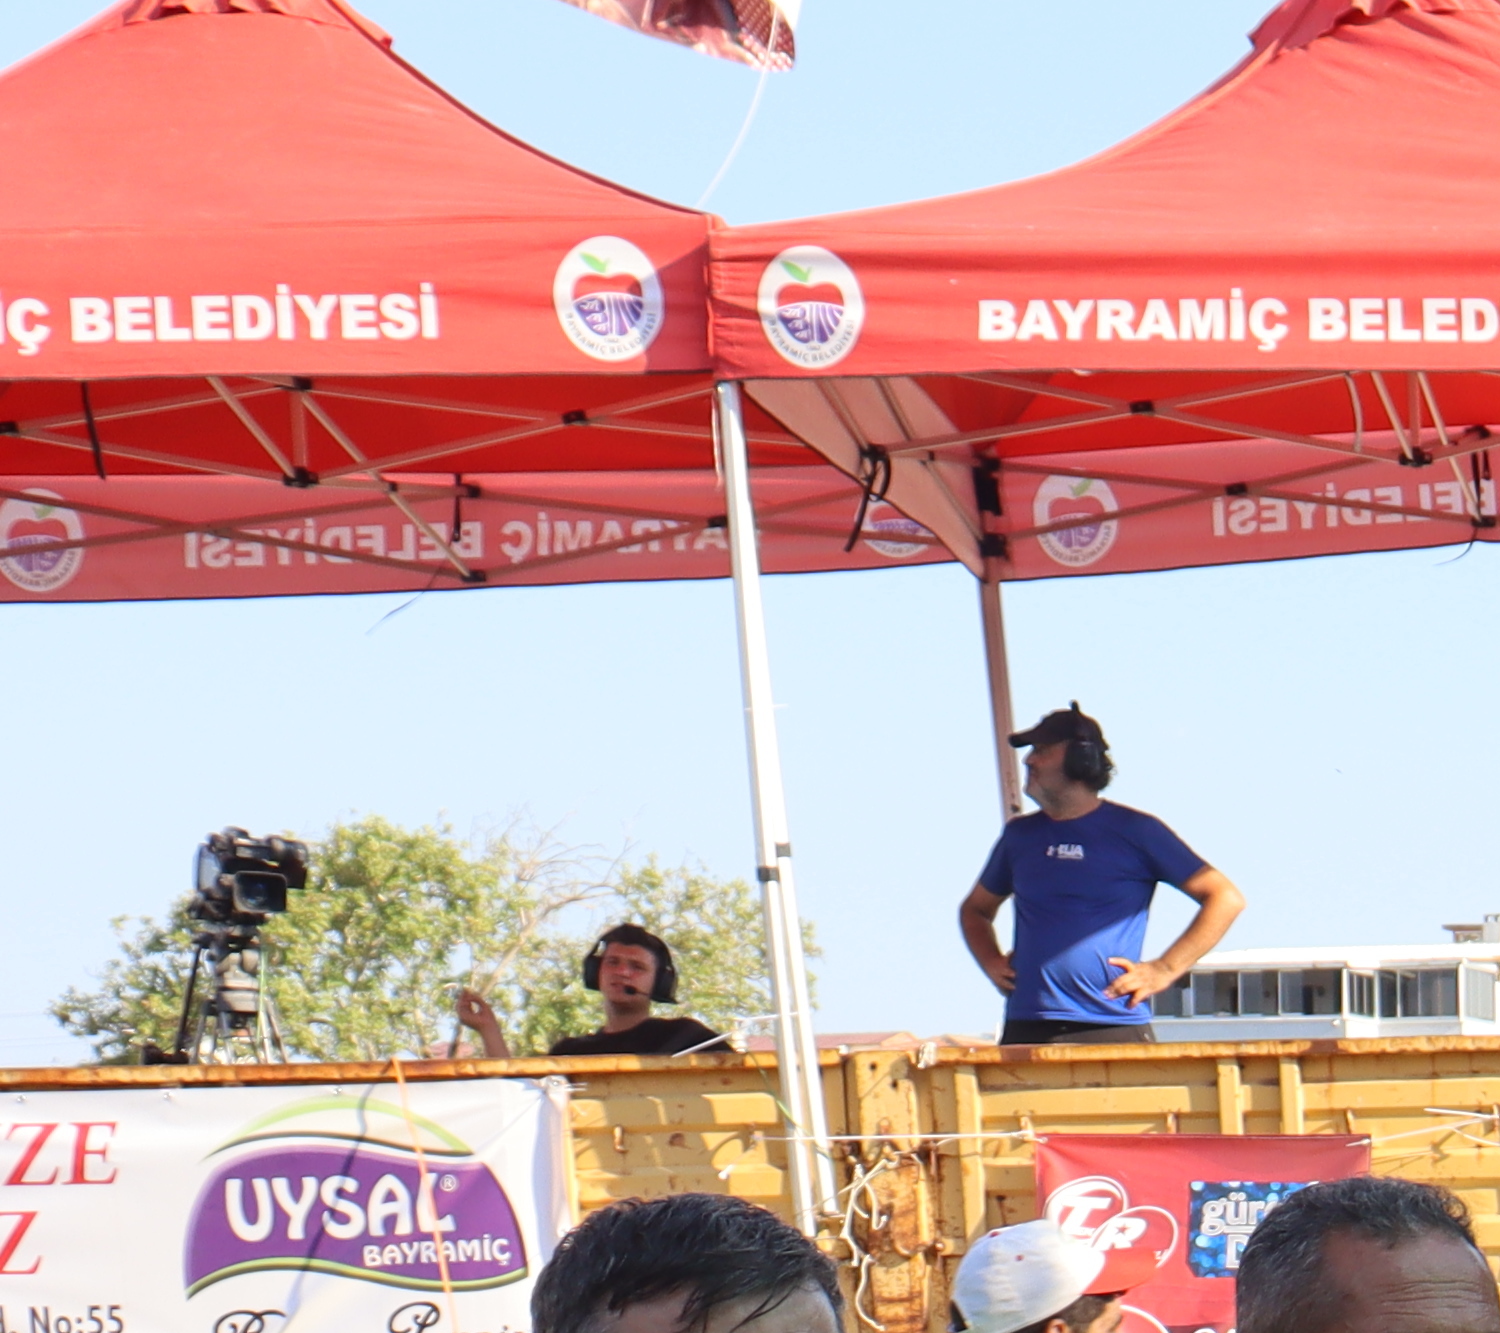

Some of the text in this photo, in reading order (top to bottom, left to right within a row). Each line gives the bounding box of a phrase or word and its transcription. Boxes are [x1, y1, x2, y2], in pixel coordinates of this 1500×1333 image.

[69, 282, 440, 343] BELEDİYESİ
[978, 286, 1289, 352] BAYRAMİÇ
[225, 1172, 456, 1243] UYSAL
[362, 1233, 512, 1267] BAYRAMİÇ
